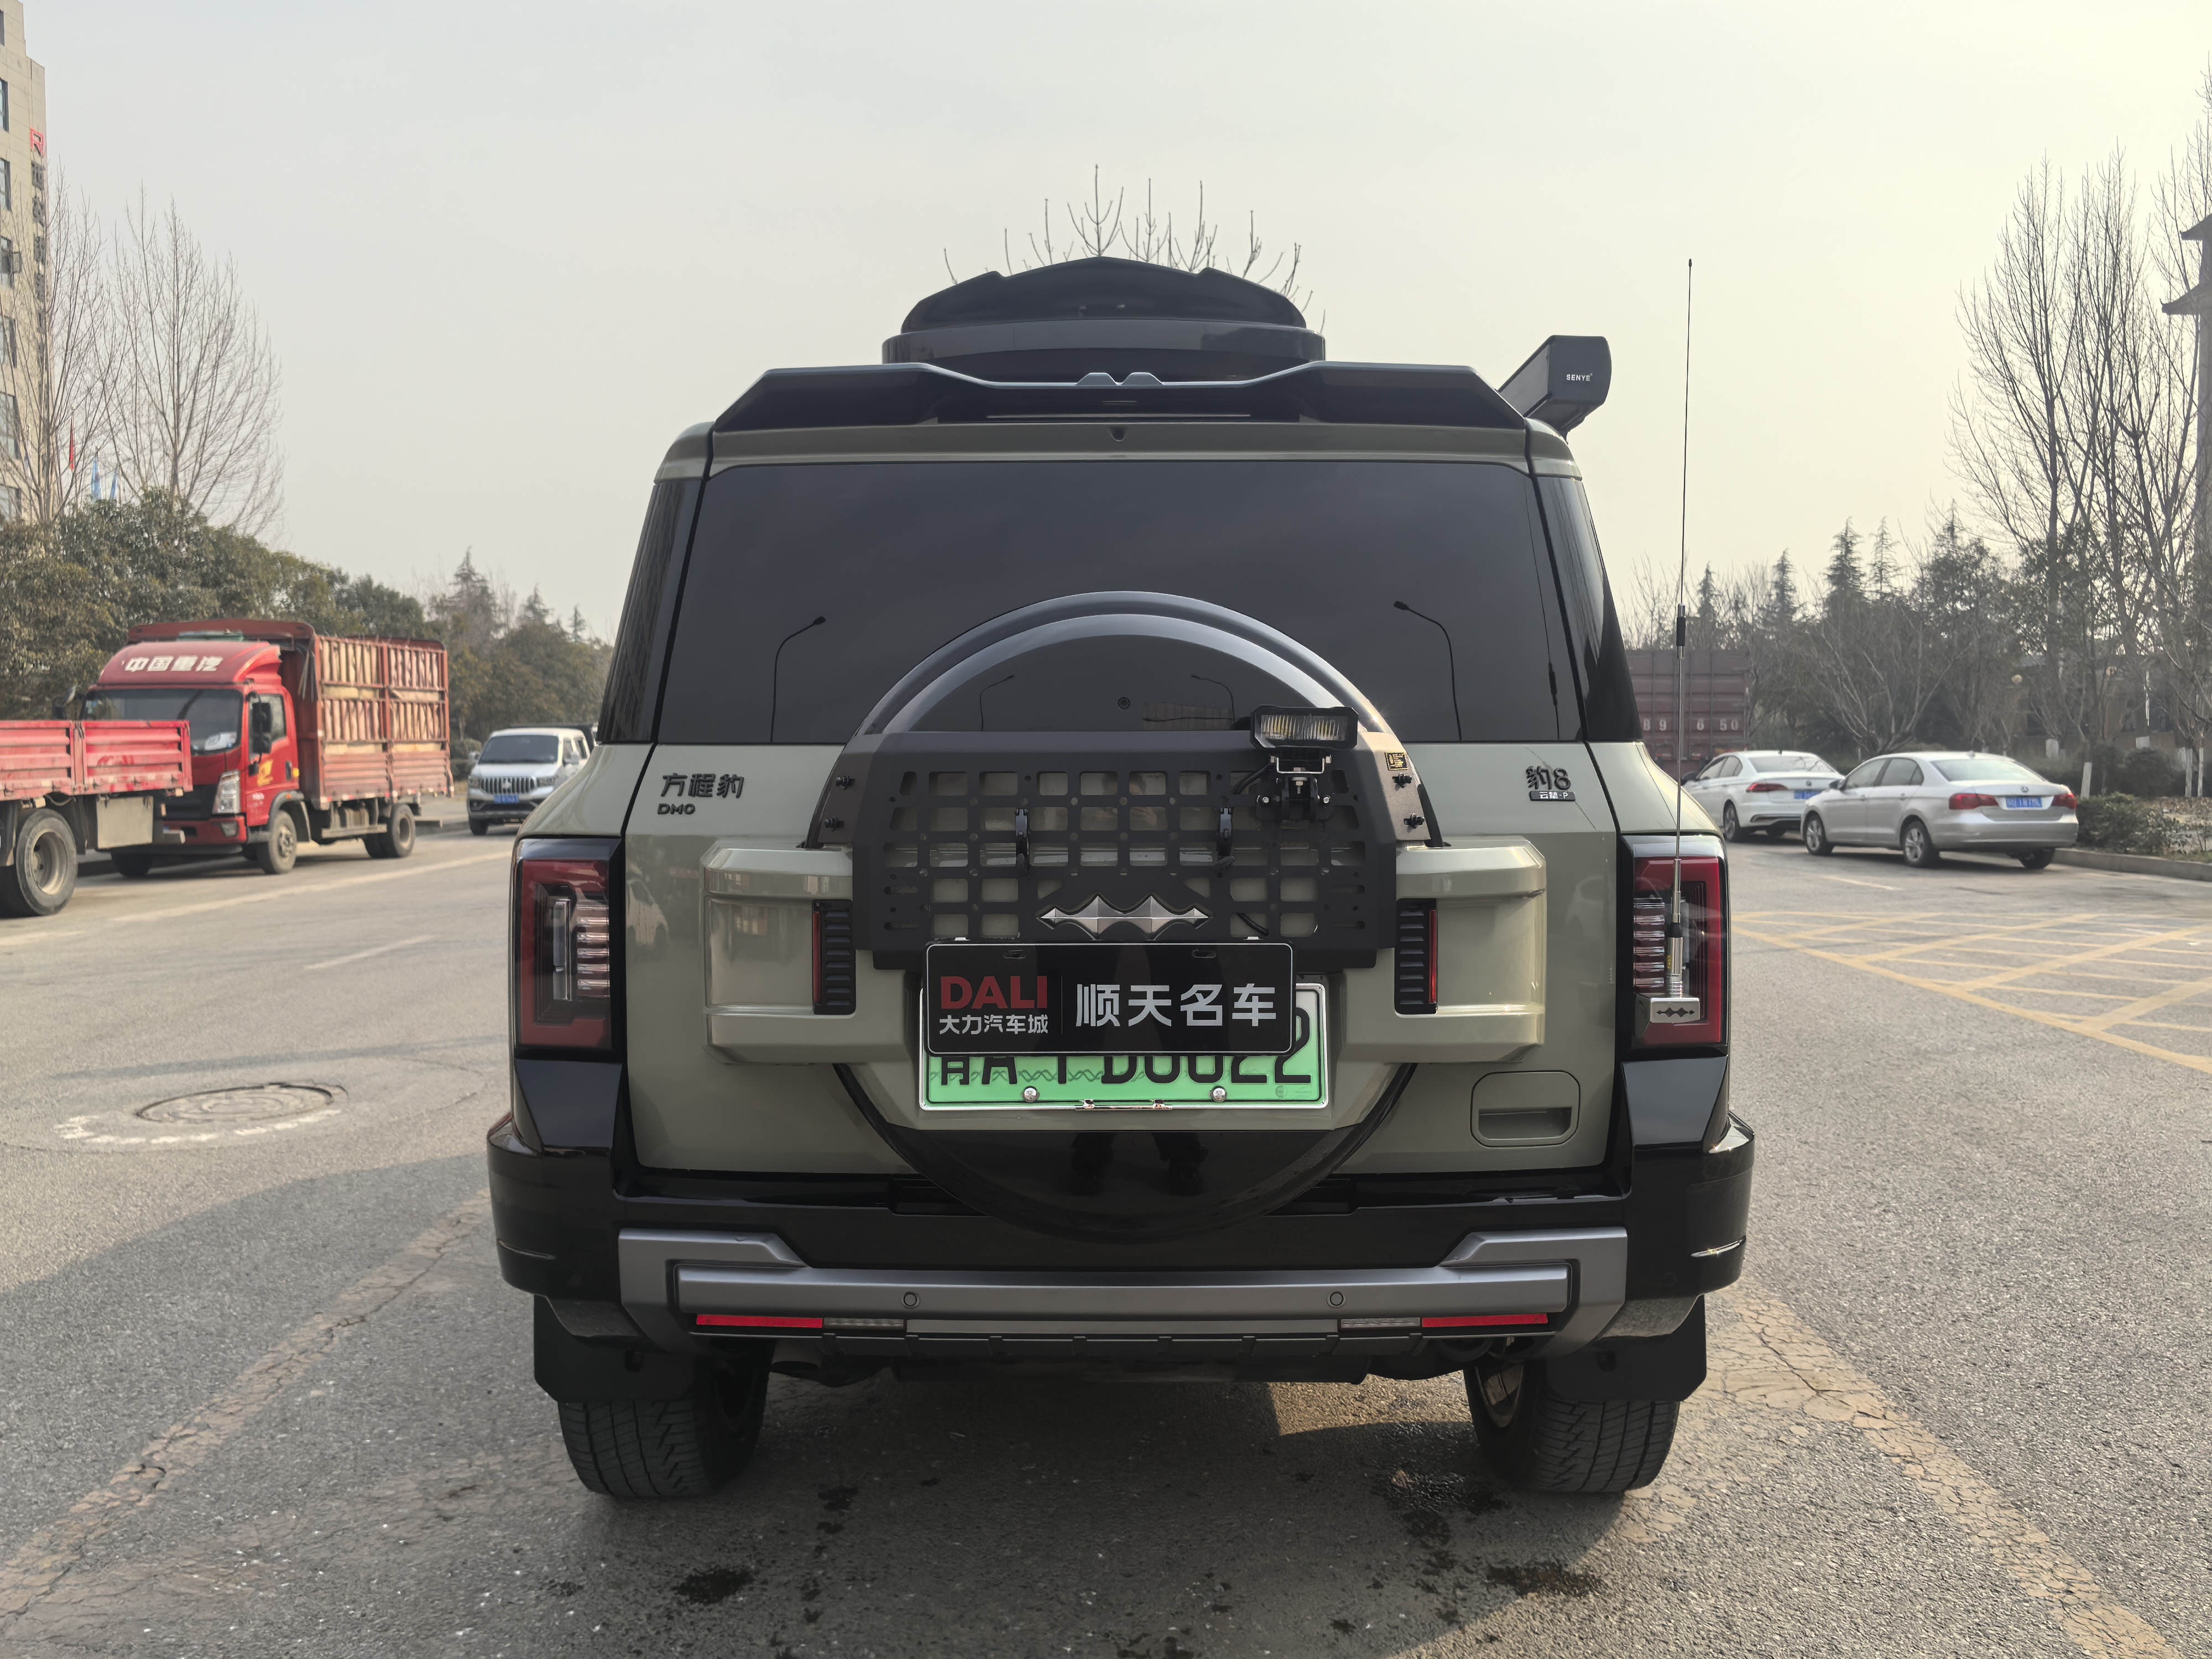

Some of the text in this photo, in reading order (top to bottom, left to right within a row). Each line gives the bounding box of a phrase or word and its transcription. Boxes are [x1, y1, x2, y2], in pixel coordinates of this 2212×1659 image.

[125, 655, 223, 672] 中国重汽
[661, 773, 744, 798] 方程豹
[1526, 766, 1571, 790] 豹8
[658, 804, 696, 815] DMO
[941, 975, 1047, 1009] DALI
[1076, 983, 1276, 1027] 顺天名车
[940, 1014, 1048, 1035] 大力汽车城
